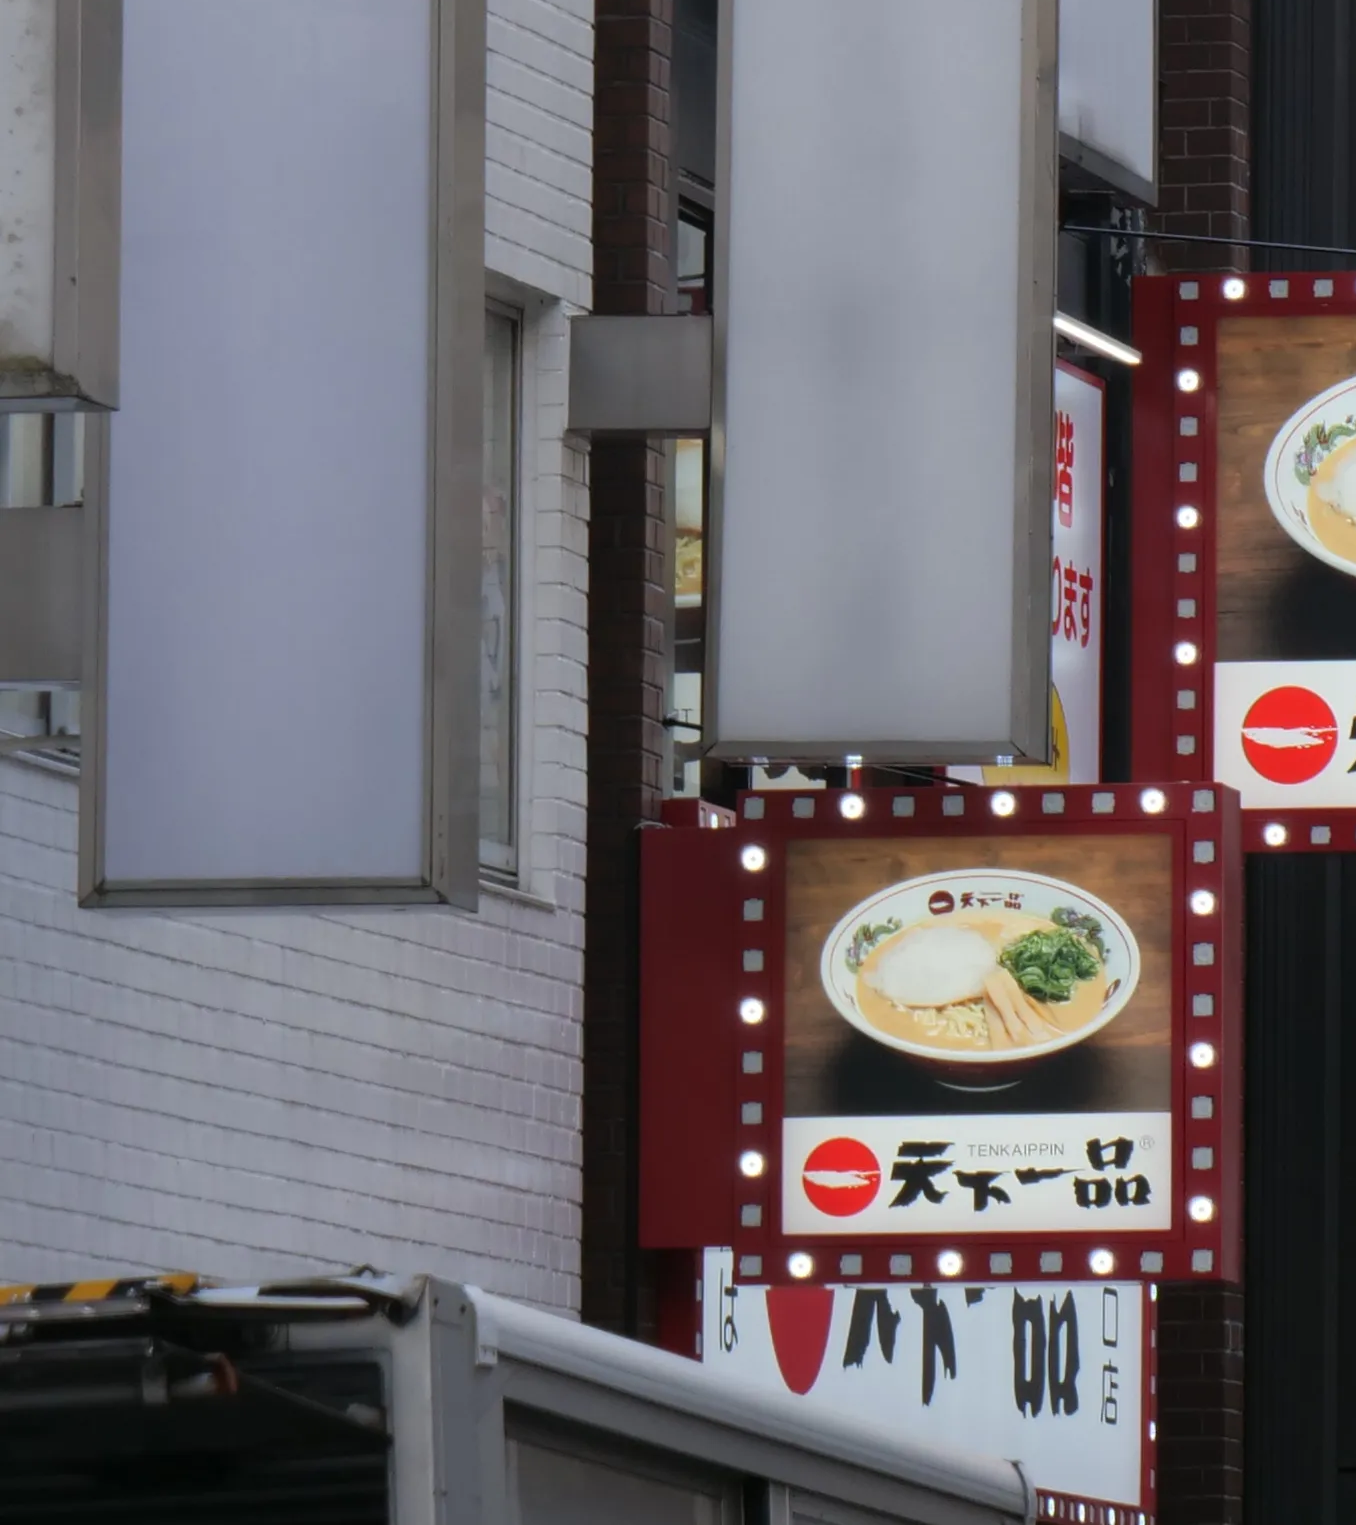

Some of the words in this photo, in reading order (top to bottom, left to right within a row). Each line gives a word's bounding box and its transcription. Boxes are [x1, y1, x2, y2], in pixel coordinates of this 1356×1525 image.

[888, 1135, 1151, 1212] 天下一品
[967, 1141, 1066, 1159] TENKAIPPIN
